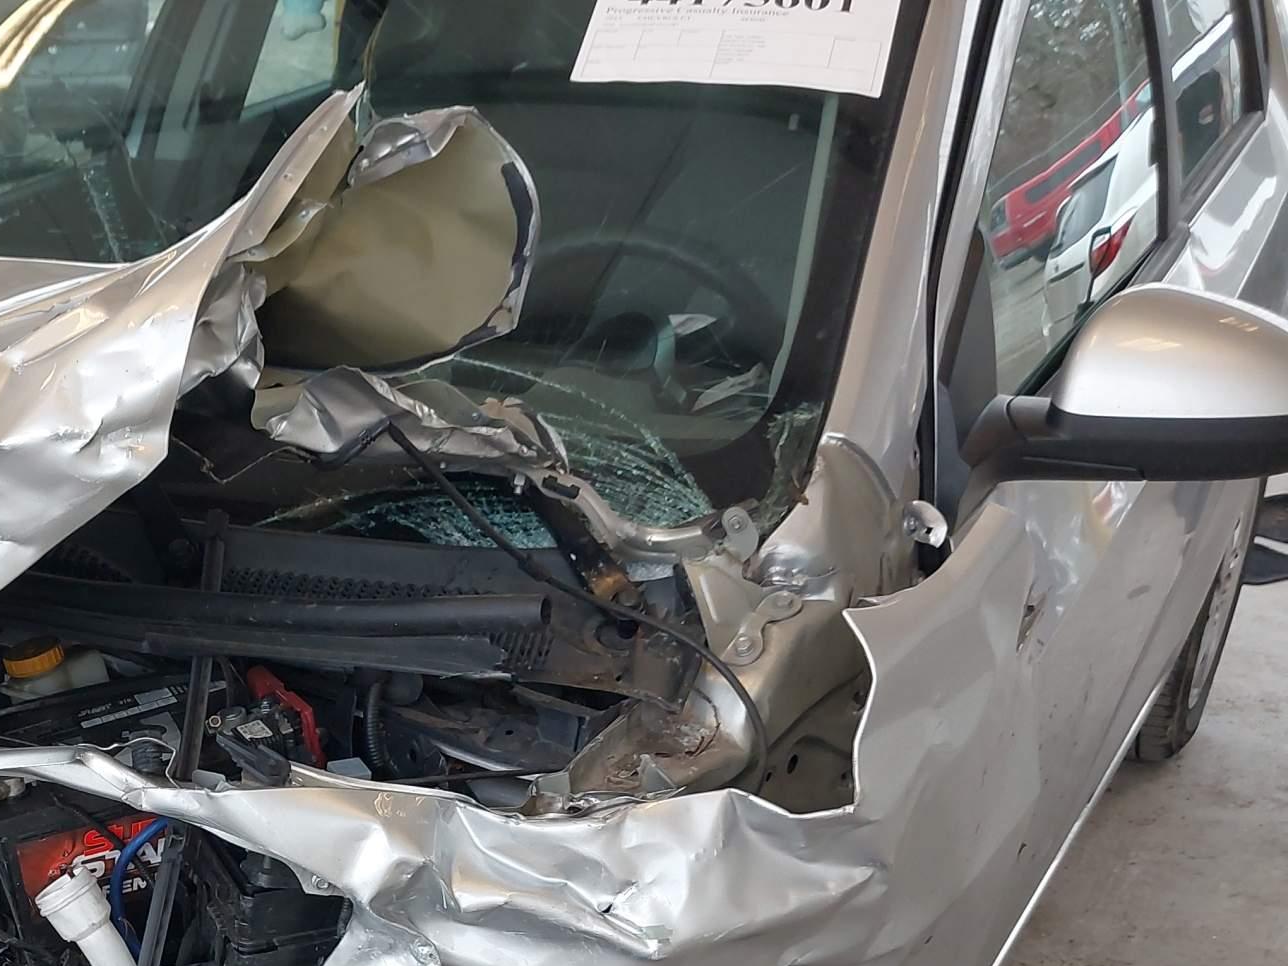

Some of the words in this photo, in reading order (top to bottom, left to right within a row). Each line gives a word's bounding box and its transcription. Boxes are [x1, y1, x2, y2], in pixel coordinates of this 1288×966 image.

[605, 7, 674, 16] Progressive
[676, 7, 727, 16] Casualty
[731, 8, 790, 17] Insurance
